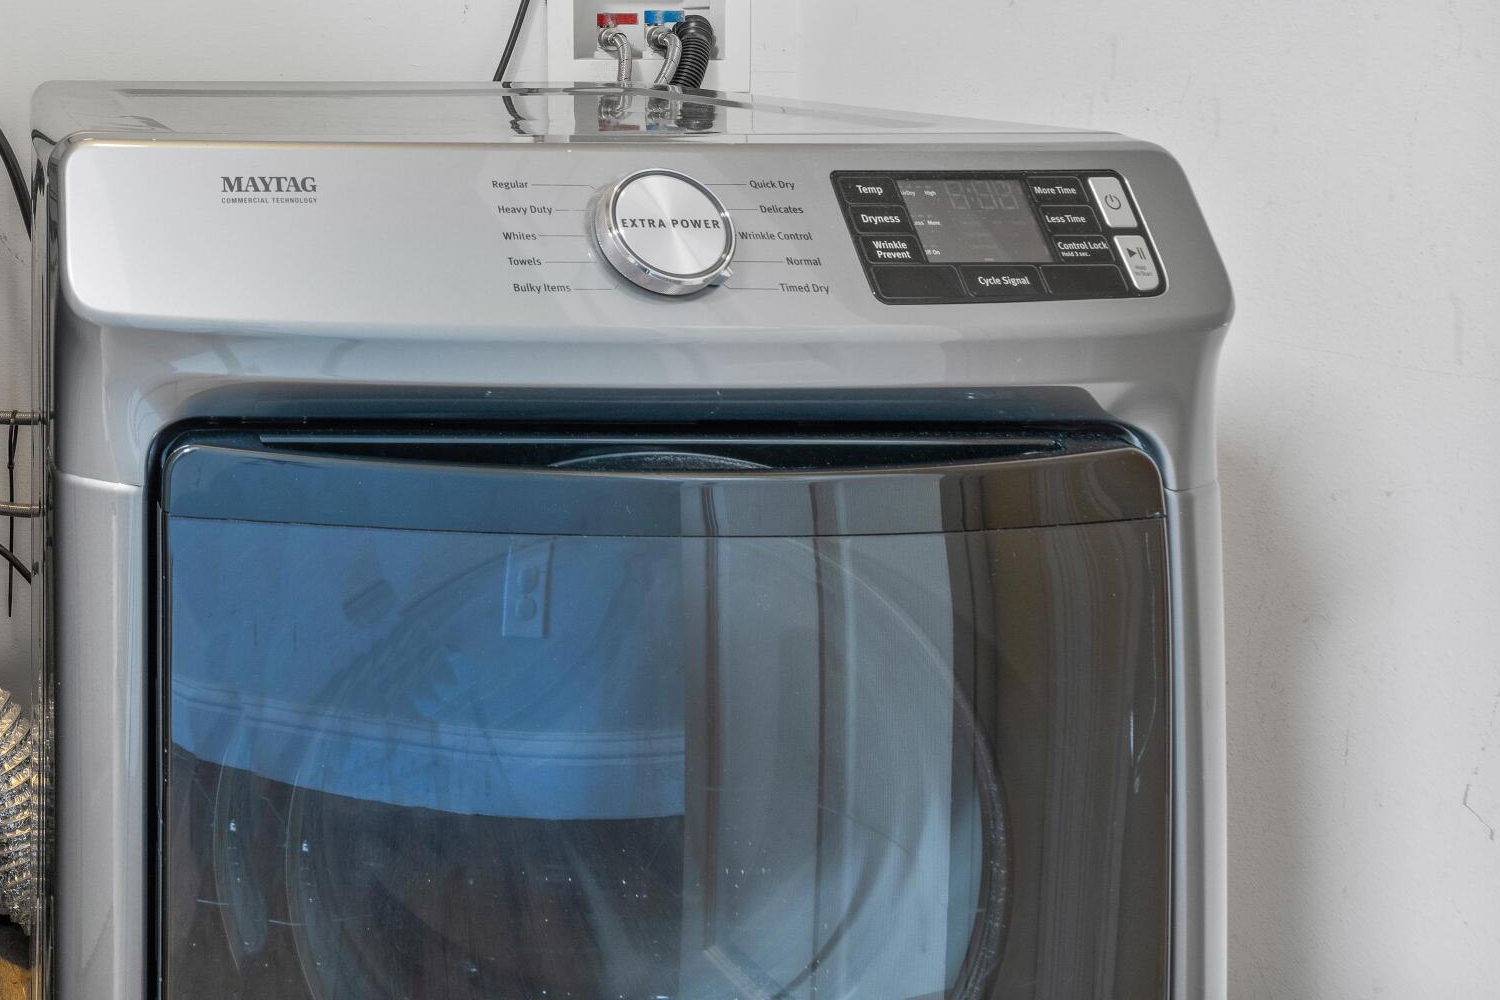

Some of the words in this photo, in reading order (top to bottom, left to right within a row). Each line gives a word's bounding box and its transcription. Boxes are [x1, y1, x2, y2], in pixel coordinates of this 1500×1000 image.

[220, 176, 317, 193] MAYTAG
[492, 180, 528, 190] Regular
[749, 180, 774, 190] Quick
[776, 180, 795, 191] Dry
[856, 185, 884, 197] Temp
[1034, 186, 1053, 195] More
[1055, 185, 1077, 195] Time
[498, 205, 527, 215] Heavy
[529, 205, 553, 215] Duty
[759, 205, 804, 214] Delicates
[621, 218, 667, 229] EXTRA
[671, 218, 721, 229] POWER
[861, 213, 901, 226] Dryness
[1045, 214, 1063, 224] Less
[1064, 214, 1086, 224] Time
[502, 231, 537, 241] Whites
[738, 231, 775, 241] Wrinkle
[777, 231, 813, 241] Control
[872, 240, 908, 250] Wrinkle
[1057, 240, 1089, 251] Control
[1090, 240, 1109, 250] Lock
[876, 250, 912, 260] Prevent
[508, 257, 542, 266] Towels
[786, 256, 822, 266] Normal
[978, 276, 1000, 287] Cycle
[1001, 276, 1031, 288] Signal
[513, 283, 543, 294] Bulky
[545, 283, 572, 293] Items
[780, 283, 809, 293] Timed
[811, 283, 830, 294] Dry
